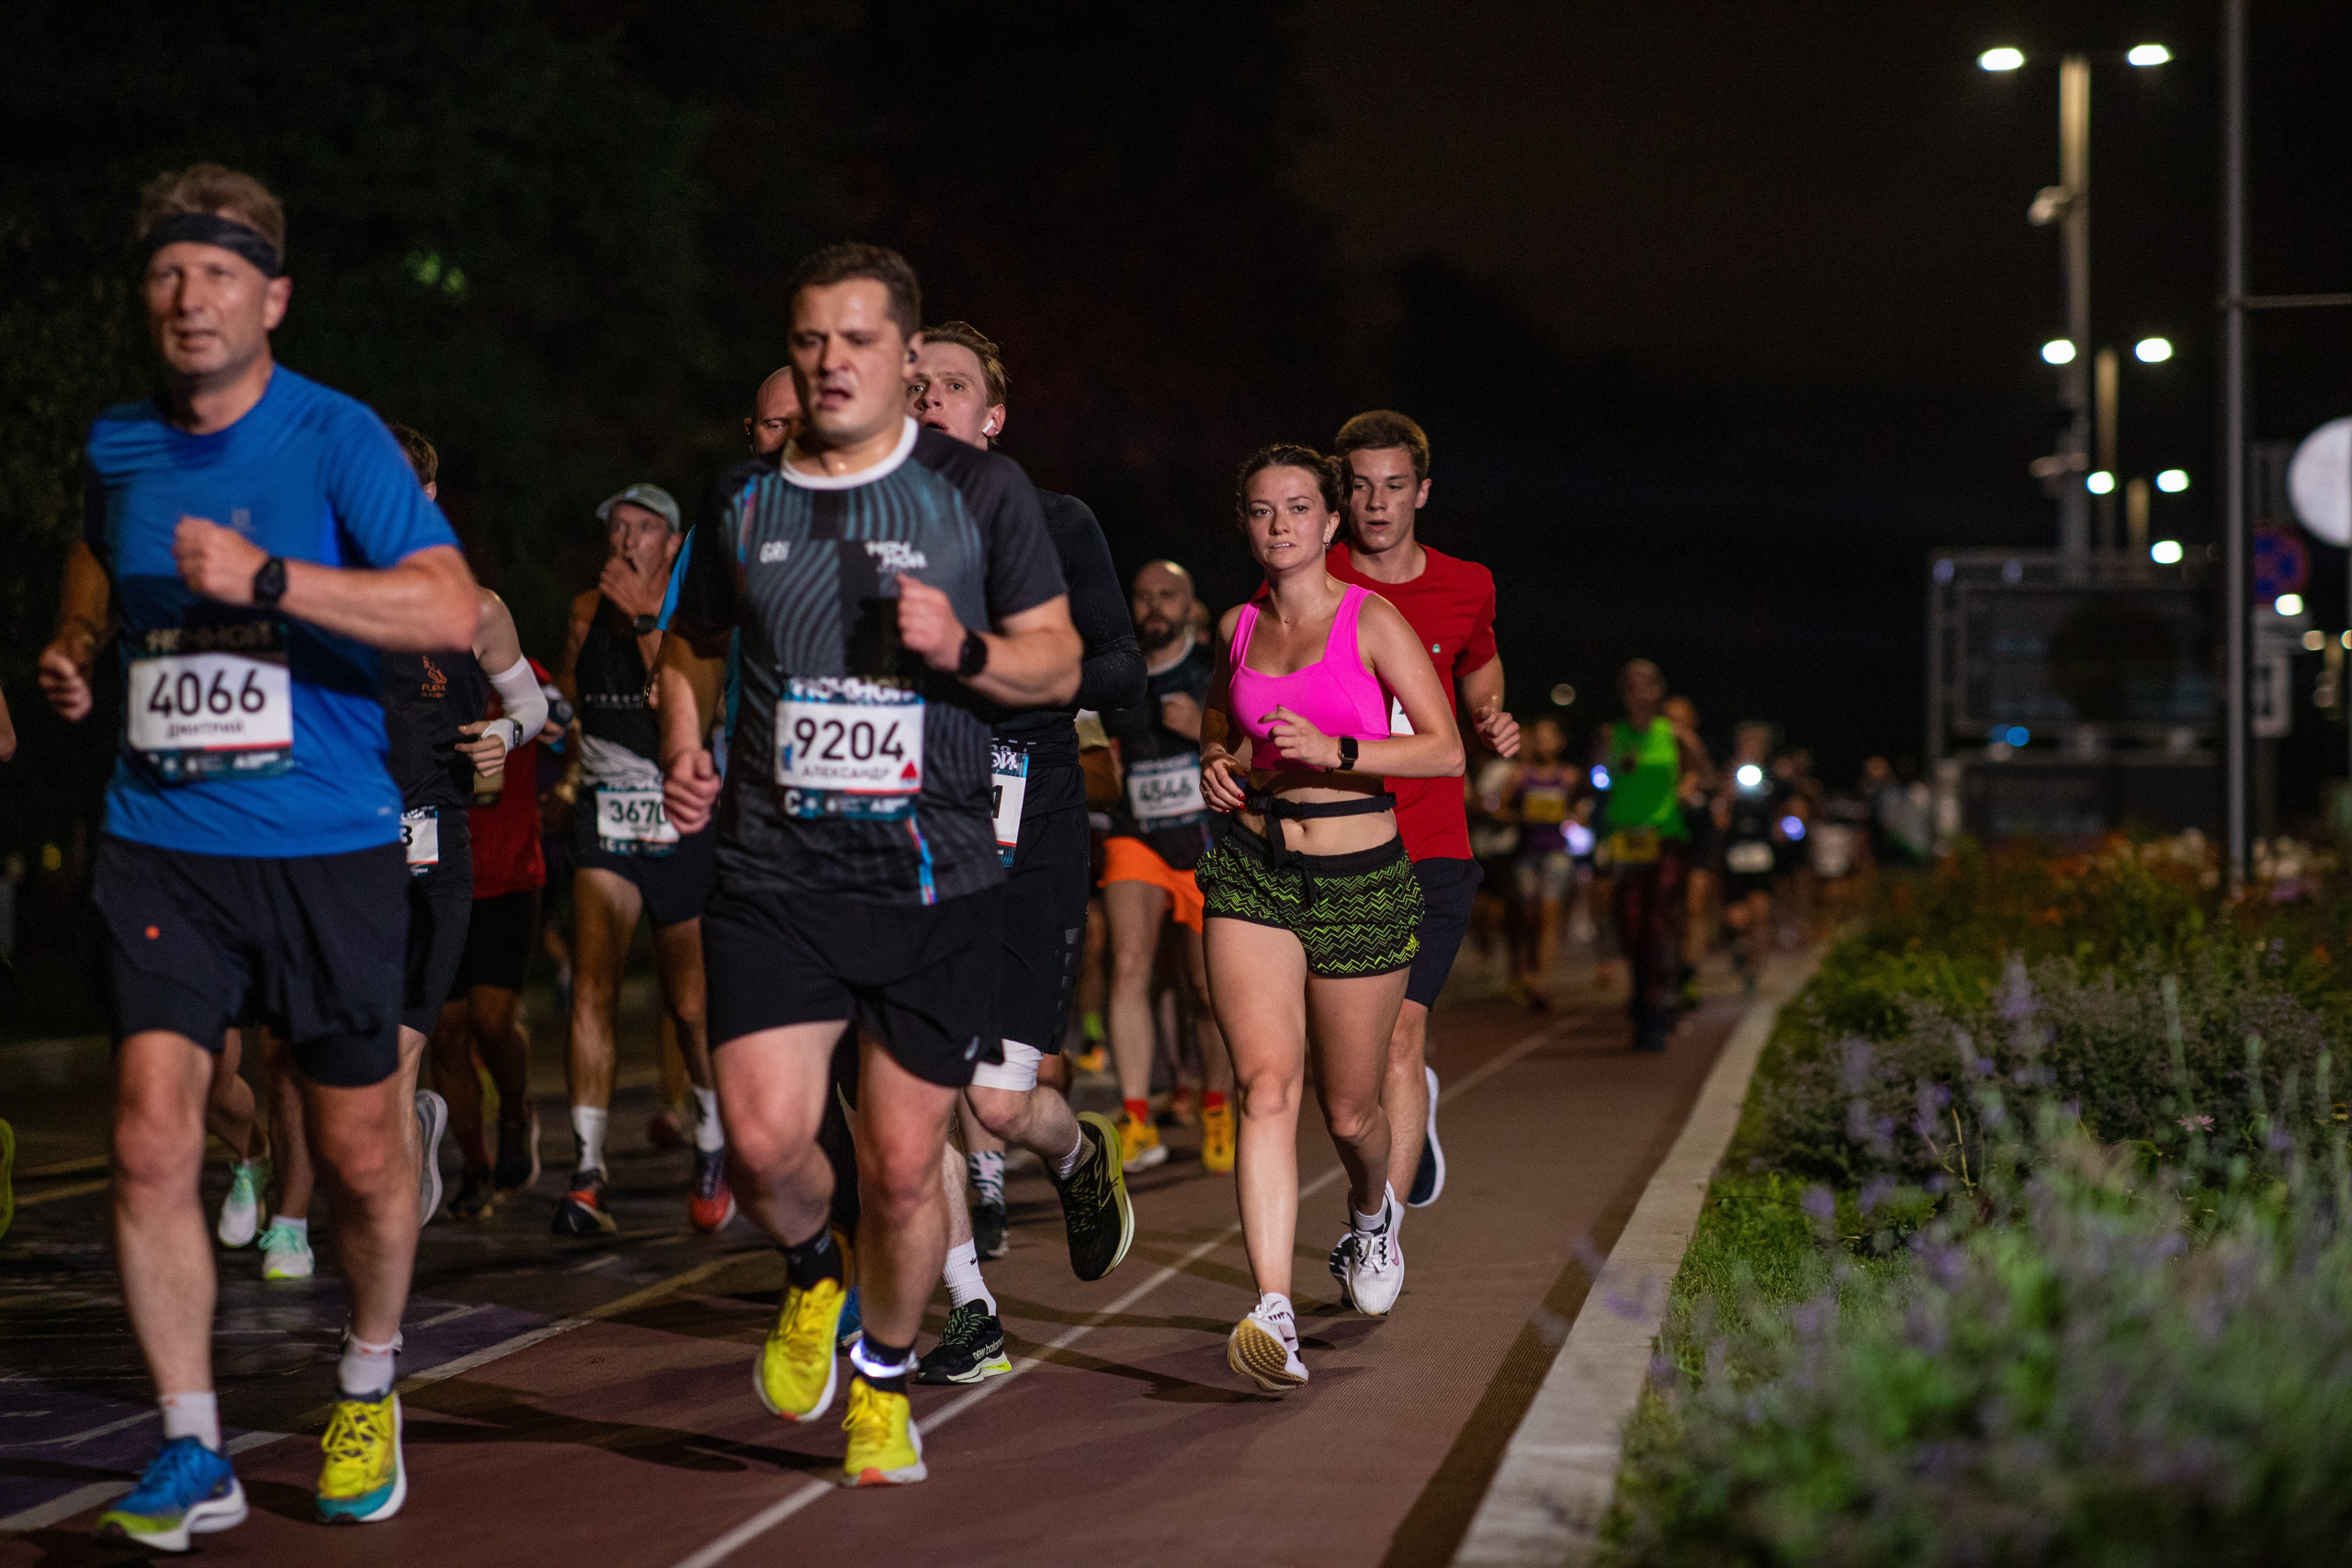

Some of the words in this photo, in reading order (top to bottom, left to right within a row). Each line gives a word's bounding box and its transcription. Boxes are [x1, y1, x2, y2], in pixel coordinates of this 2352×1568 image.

[147, 670, 266, 717] 4066
[795, 717, 905, 761] 9204
[972, 1348, 986, 1361] new
[985, 1333, 1005, 1356] balanc
